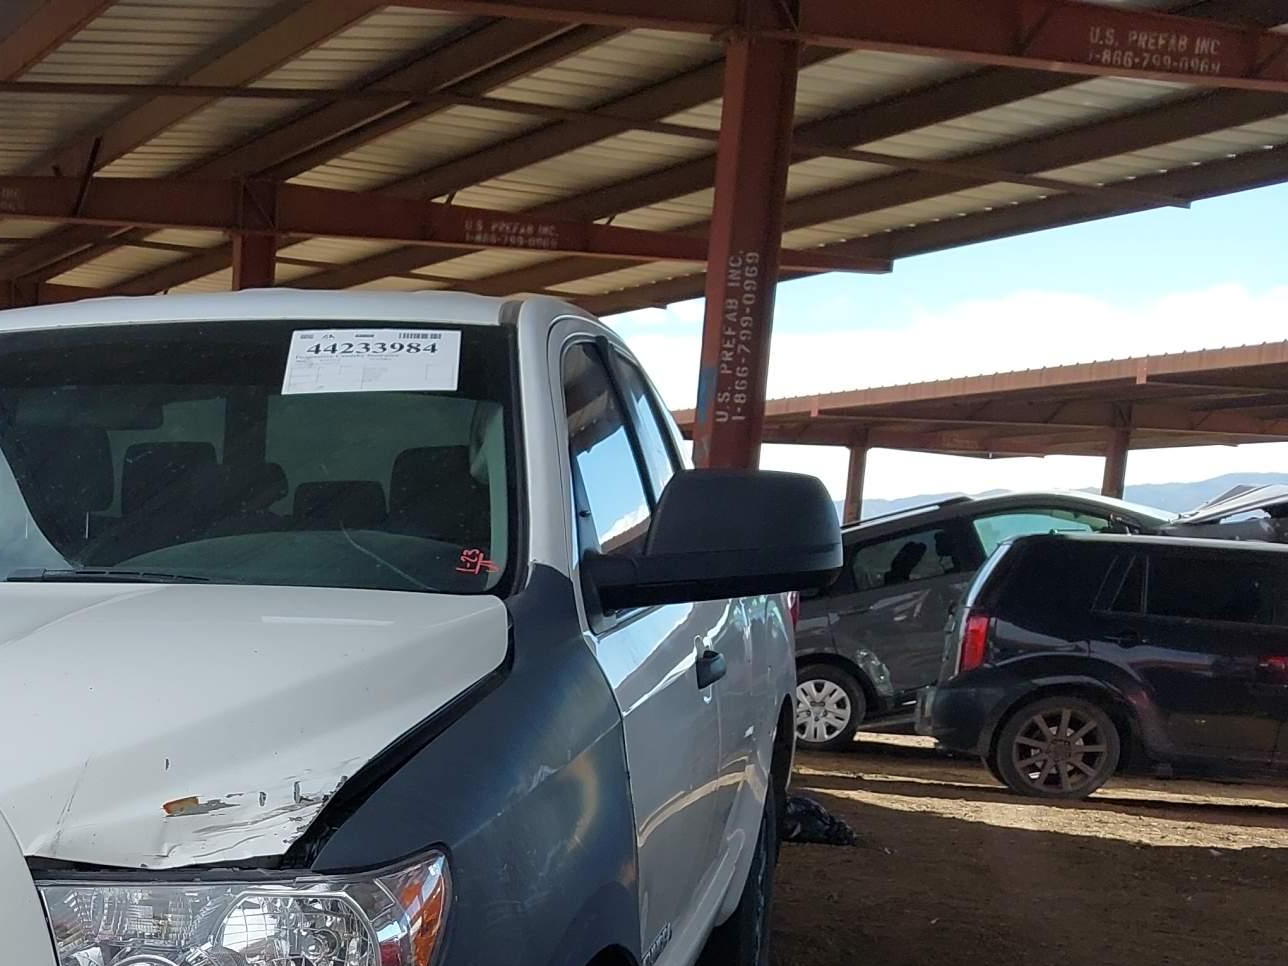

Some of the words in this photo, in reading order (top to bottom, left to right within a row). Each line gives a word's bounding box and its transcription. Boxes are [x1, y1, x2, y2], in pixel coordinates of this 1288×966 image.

[1089, 27, 1119, 46] U.S.
[1128, 30, 1189, 53] PREFAB
[728, 250, 745, 287] INC.
[306, 341, 439, 355] 44233984
[720, 300, 739, 374] PREFAB
[732, 252, 760, 421] 1-866-799-0969
[715, 387, 733, 422] U.S.
